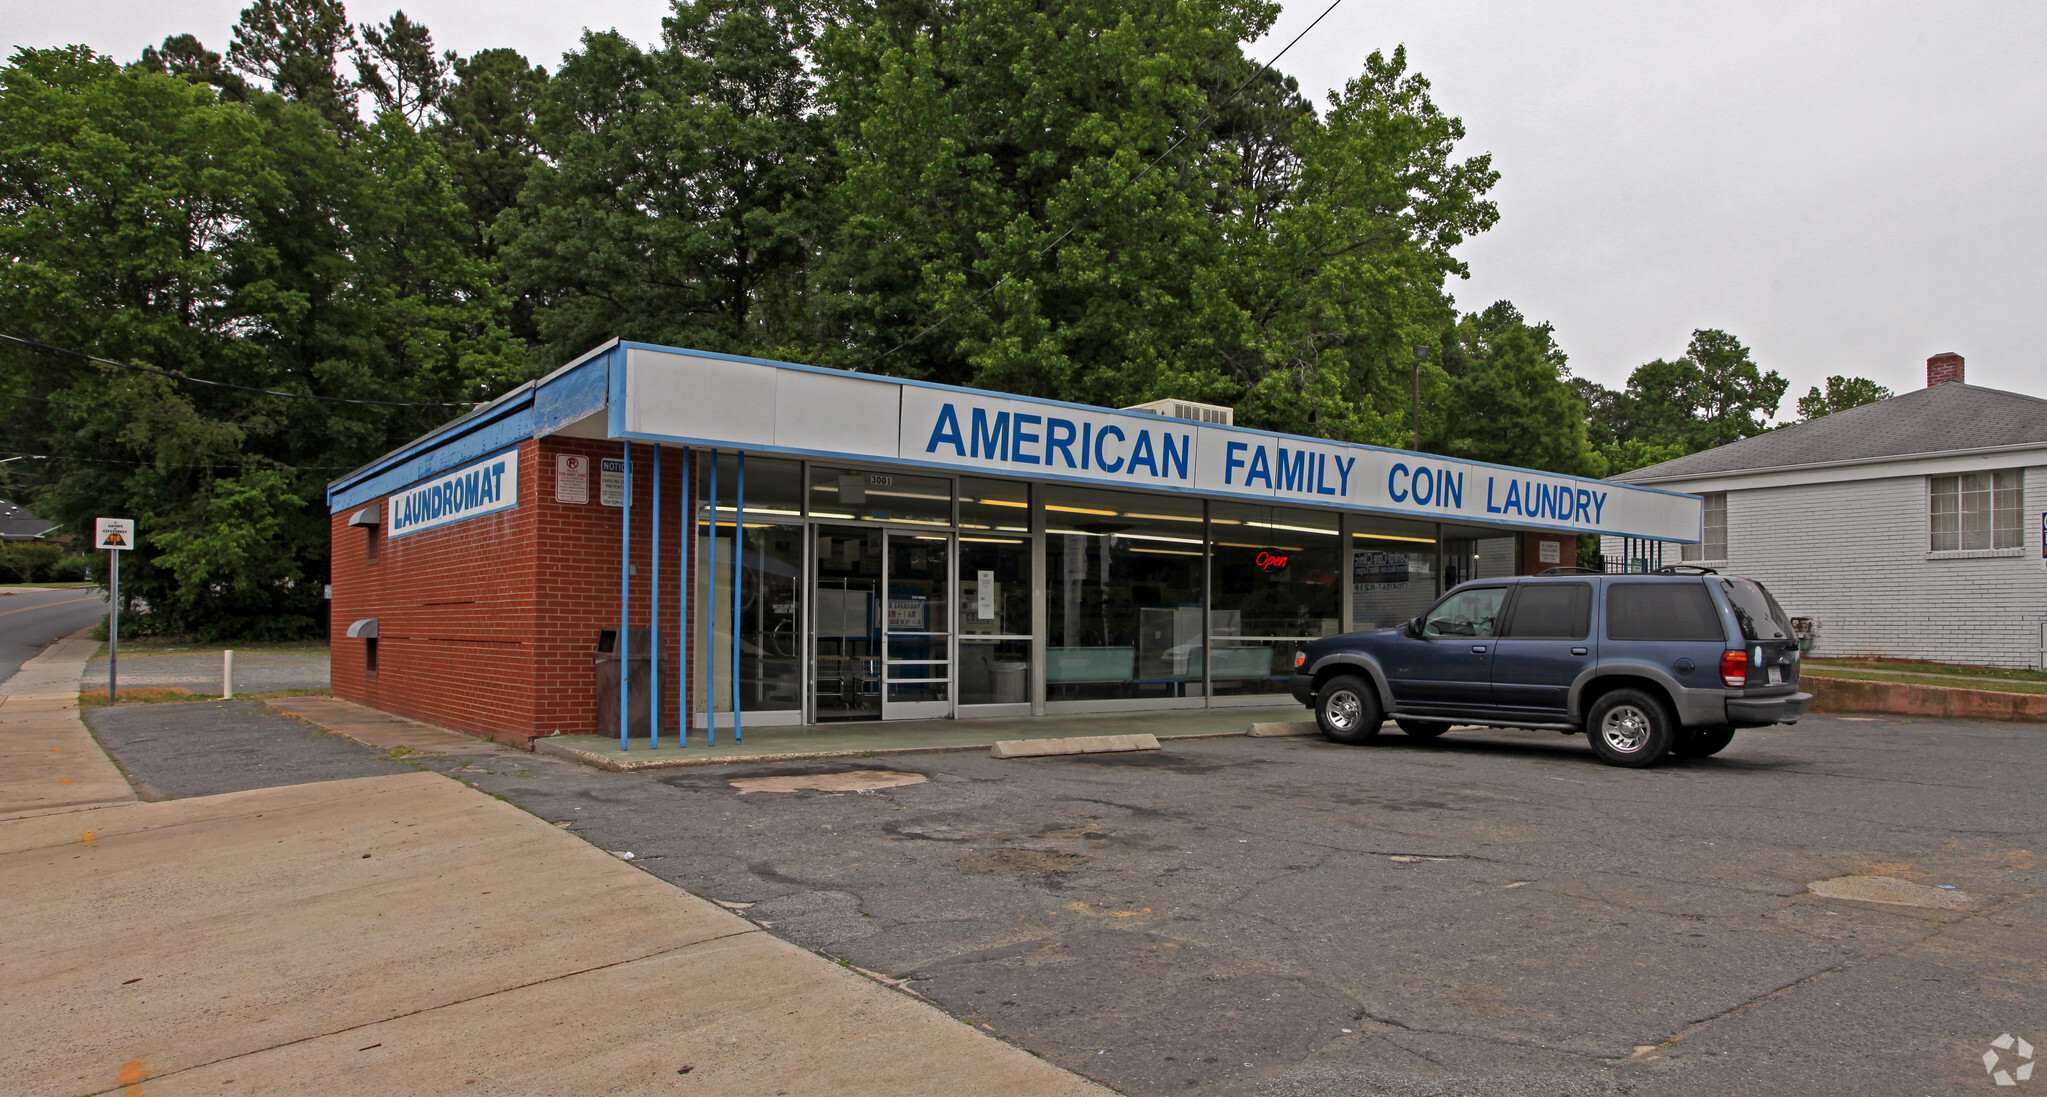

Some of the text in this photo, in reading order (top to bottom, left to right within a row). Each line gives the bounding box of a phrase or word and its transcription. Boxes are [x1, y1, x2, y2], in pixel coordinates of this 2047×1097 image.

[603, 462, 624, 471] NOTIC
[926, 403, 1608, 525] AMERICAN FAMILY COIN LAUNDRY
[871, 476, 891, 485] 3001
[394, 461, 505, 530] LAUNDROMAT
[1256, 551, 1288, 570] Open
